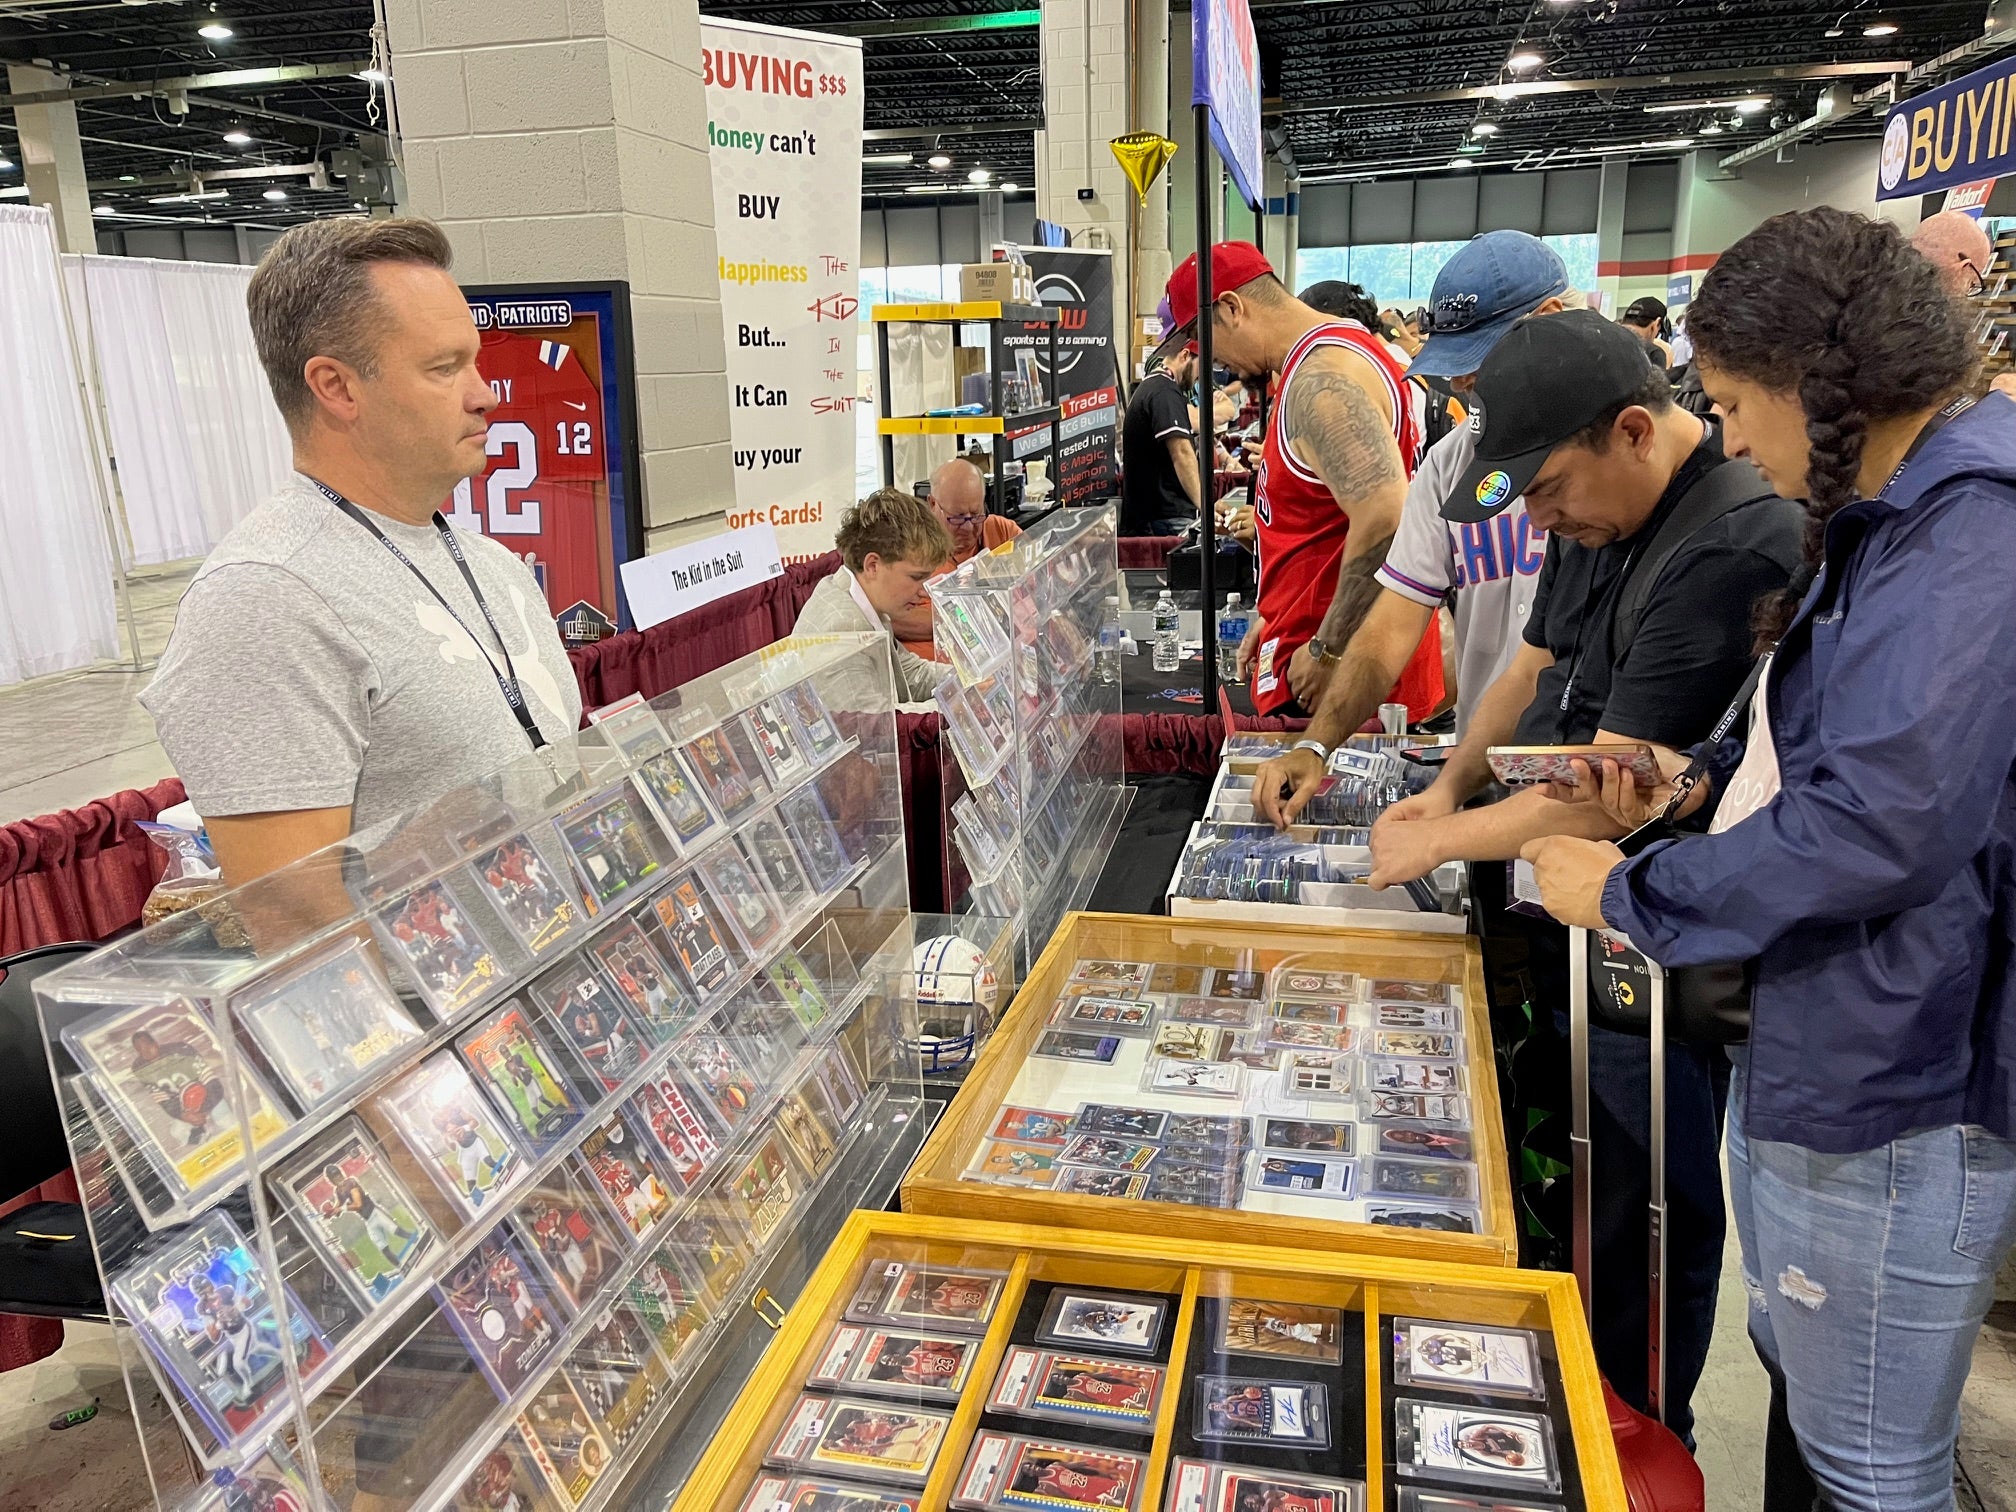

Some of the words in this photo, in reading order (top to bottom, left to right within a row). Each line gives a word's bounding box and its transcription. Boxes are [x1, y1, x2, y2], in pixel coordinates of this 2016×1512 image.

[702, 48, 812, 98] BUYING
[770, 129, 816, 155] can't
[738, 193, 780, 219] BUY
[1940, 184, 1988, 212] Waldorf
[500, 305, 568, 325] PATRIOTS
[807, 292, 858, 322] KID
[738, 324, 786, 347] But...
[735, 384, 750, 407] It
[754, 384, 787, 406] Can
[1069, 392, 1108, 414] Trade
[557, 421, 591, 455] 12
[1019, 438, 1038, 451] We
[1039, 431, 1051, 443] Bu
[1080, 411, 1108, 426] Bulk
[734, 449, 757, 471] uy
[761, 447, 802, 470] your
[769, 500, 822, 527] Cards!
[672, 568, 689, 592] The
[687, 564, 703, 586] Kid
[702, 561, 712, 581] in
[712, 557, 726, 578] the
[726, 550, 744, 572] Suit
[1711, 709, 1737, 741] PANINI
[660, 1080, 711, 1153] CHIEFS
[935, 1357, 955, 1372] 23
